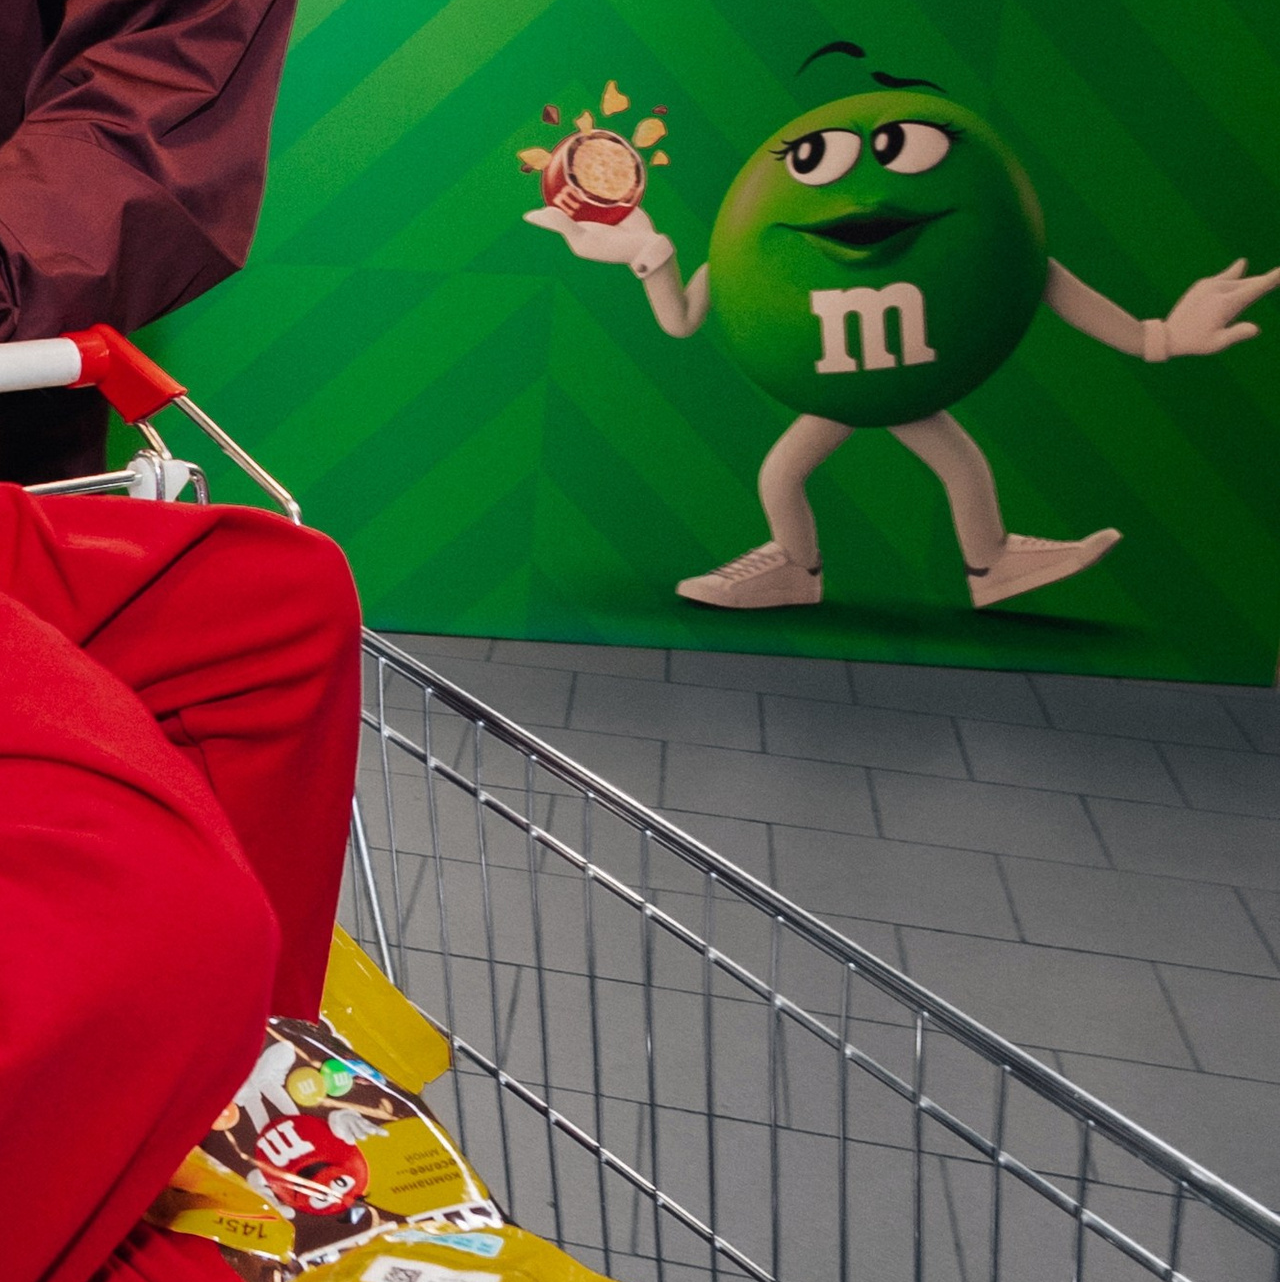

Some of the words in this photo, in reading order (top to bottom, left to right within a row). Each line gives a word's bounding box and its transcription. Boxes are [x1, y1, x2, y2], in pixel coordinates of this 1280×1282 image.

[809, 280, 938, 375] m
[396, 1157, 458, 1176] еселее...
[212, 1219, 269, 1241] 145г
